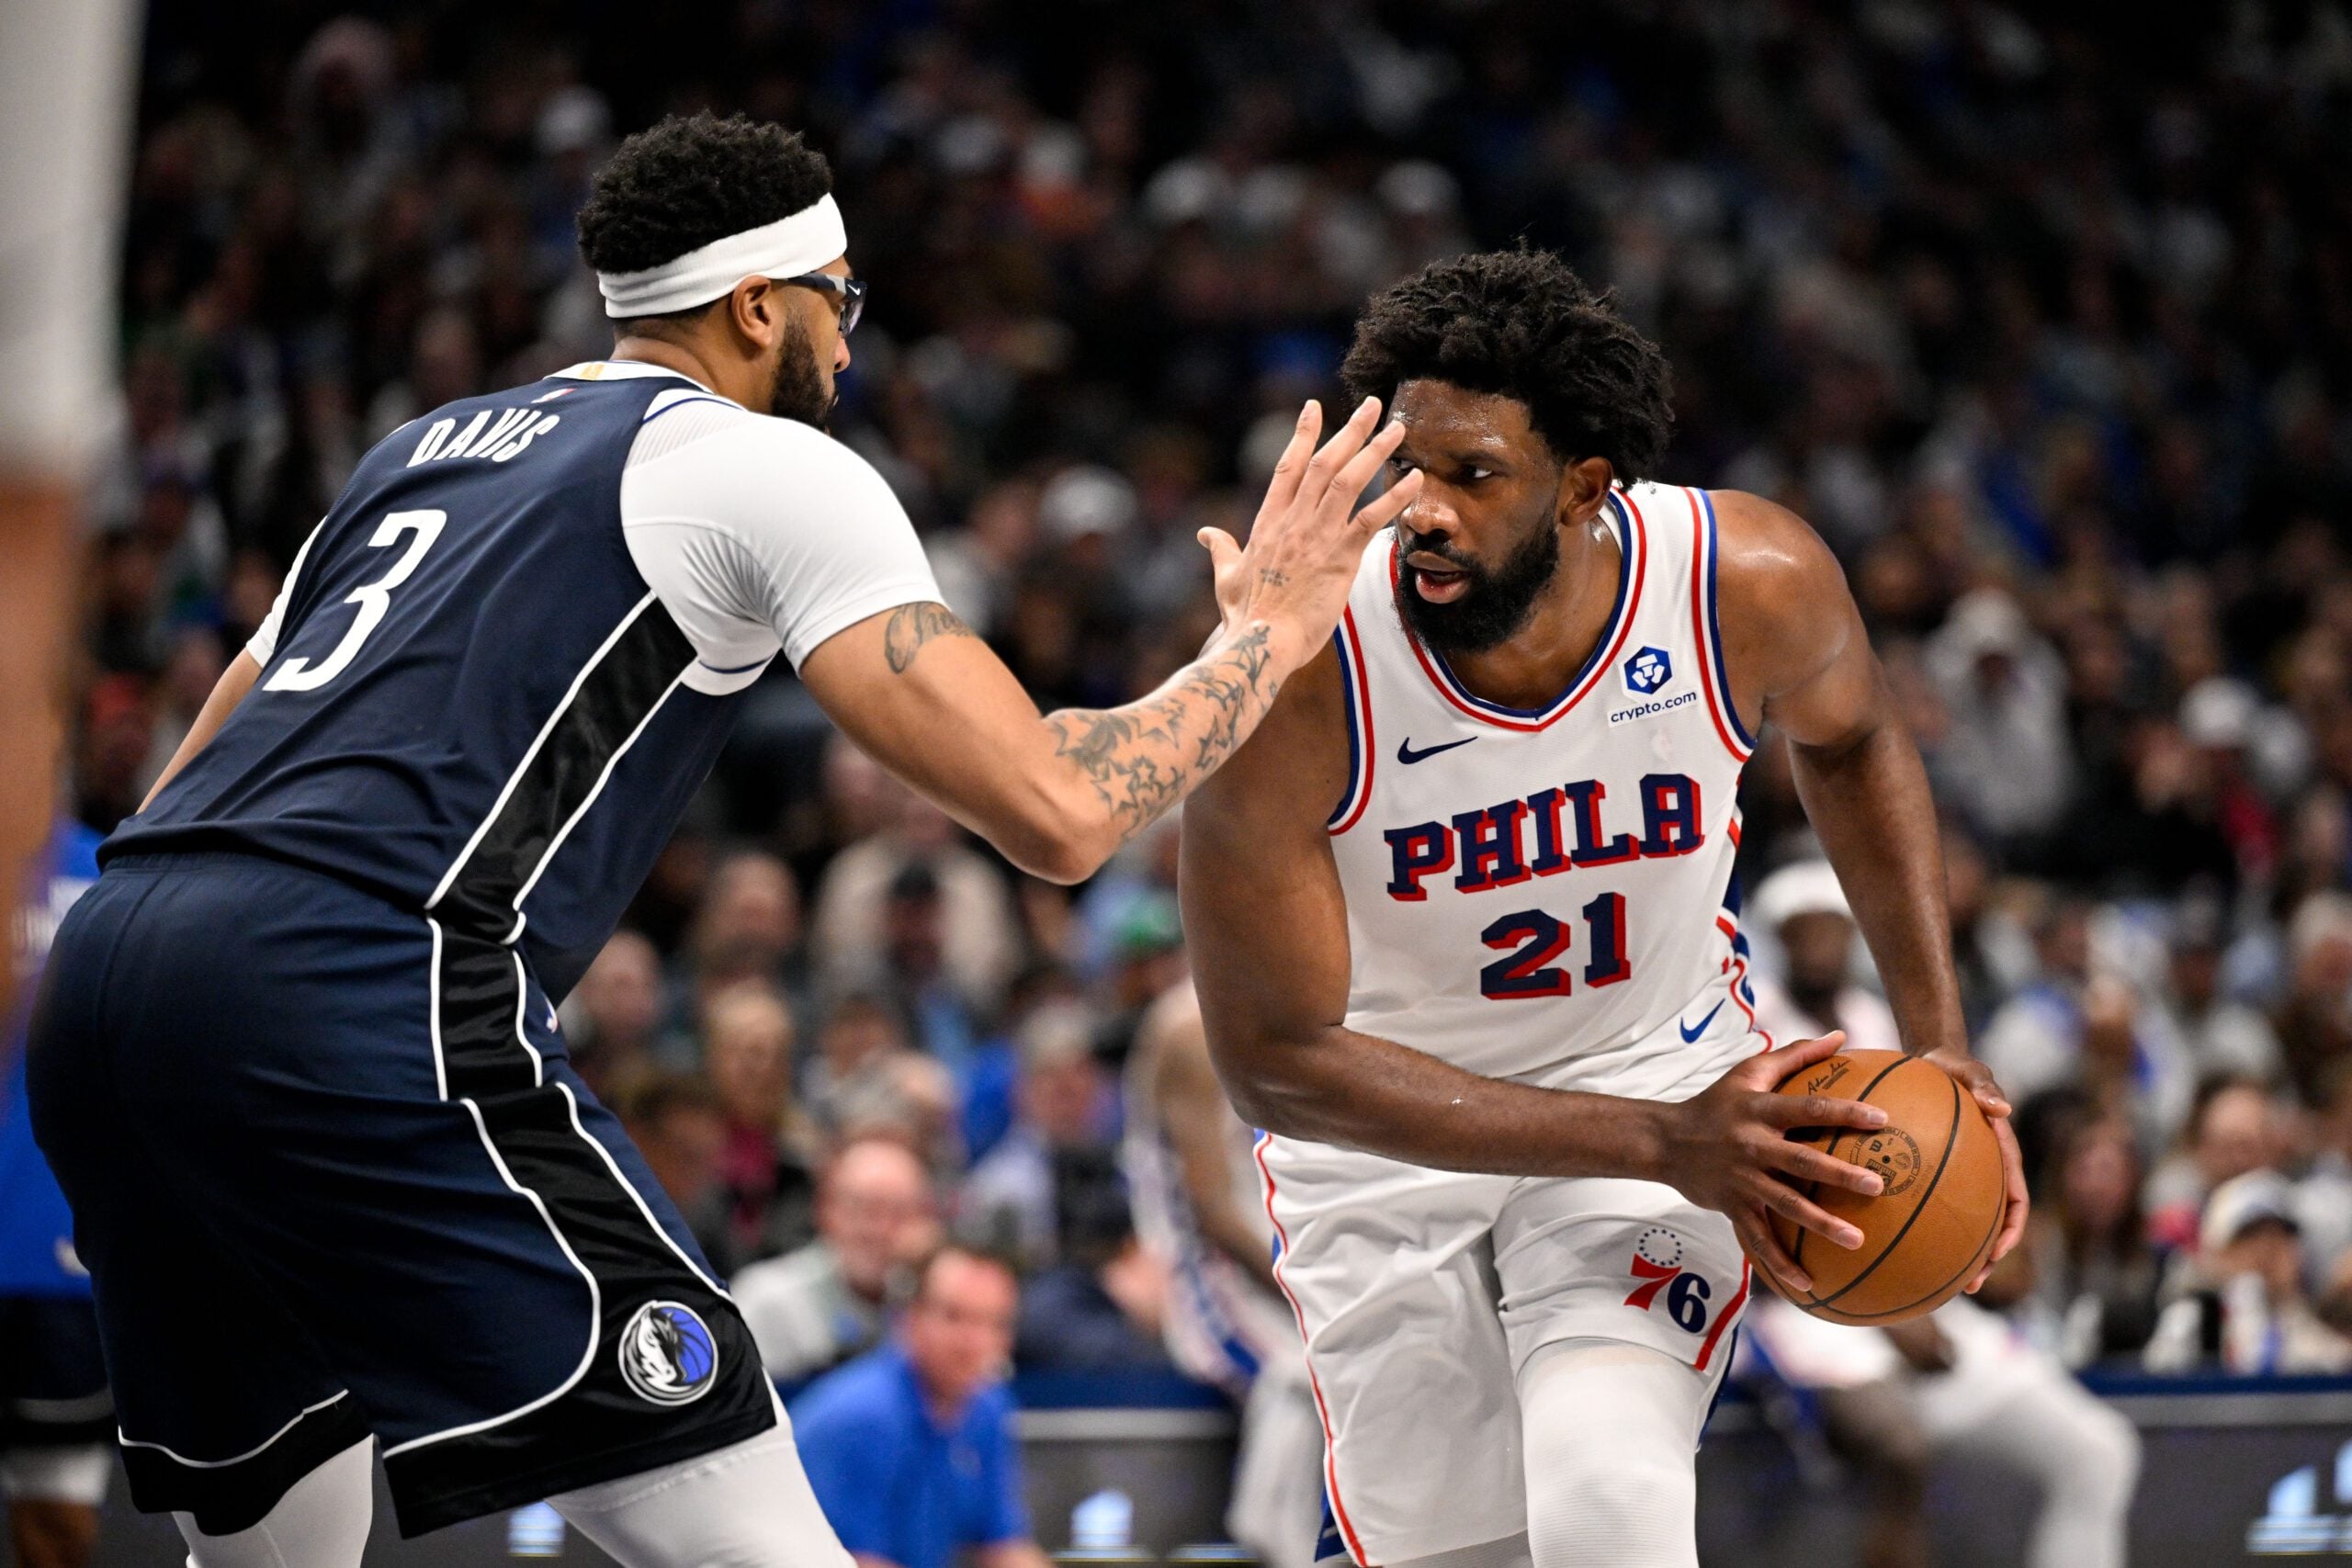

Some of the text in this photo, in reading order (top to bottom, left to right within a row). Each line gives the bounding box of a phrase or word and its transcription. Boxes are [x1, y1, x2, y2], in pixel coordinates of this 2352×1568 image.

[407, 408, 560, 468] DAVIS
[262, 509, 447, 692] 3
[1611, 692, 1697, 723] crypto.com
[1384, 773, 1705, 901] PHILA
[1480, 892, 1631, 1000] 21
[1623, 1253, 1711, 1333] 76
